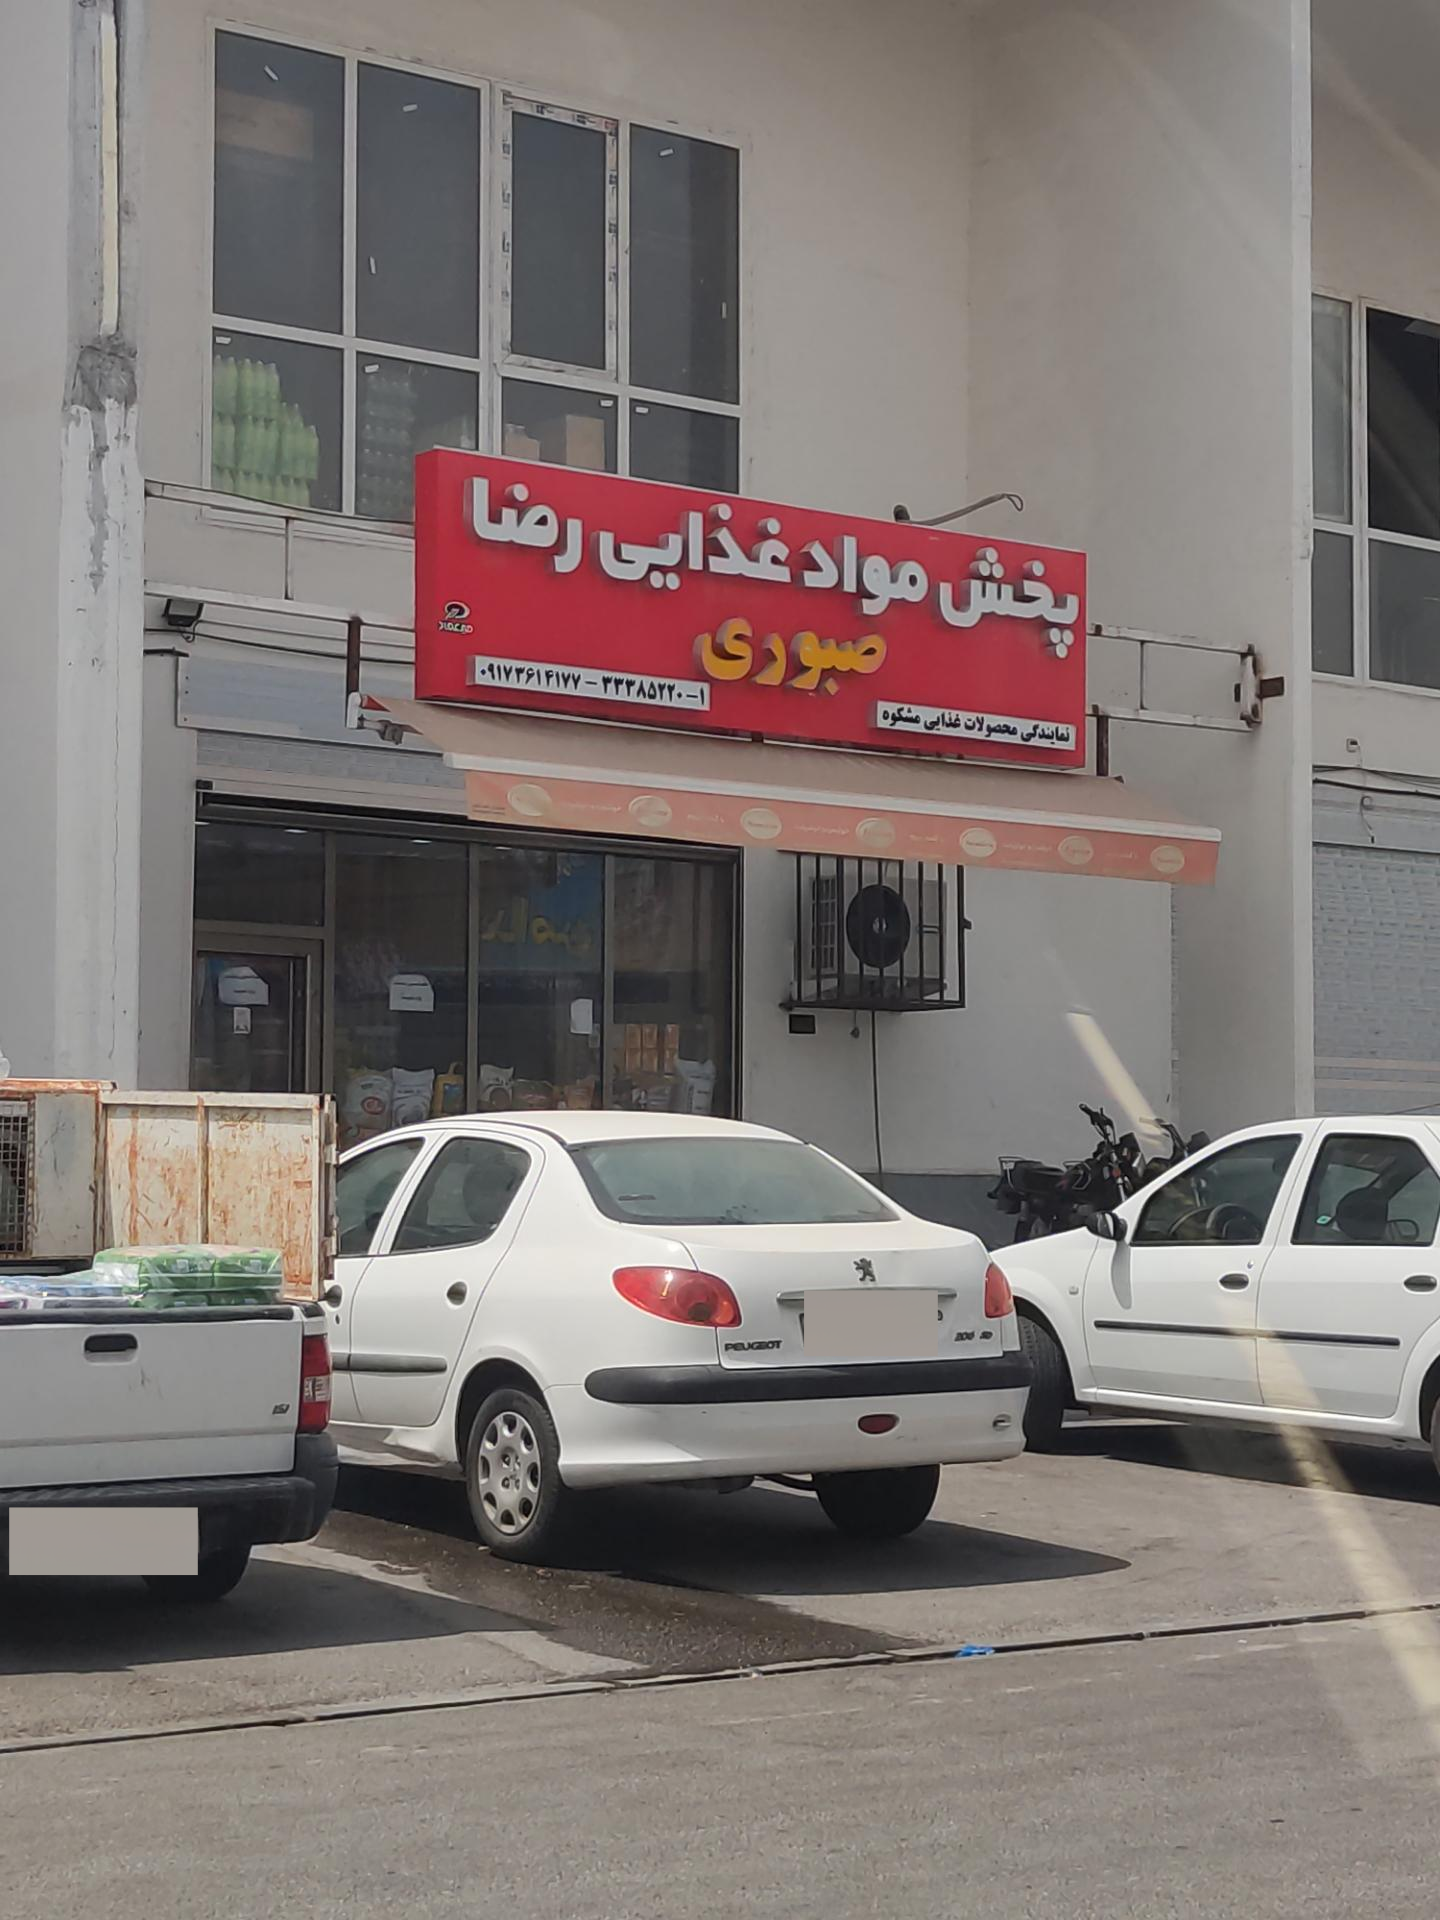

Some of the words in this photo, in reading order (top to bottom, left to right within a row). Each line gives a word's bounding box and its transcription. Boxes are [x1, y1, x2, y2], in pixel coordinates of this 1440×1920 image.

[465, 476, 583, 573] رضا
[594, 503, 792, 590] غذایی
[801, 535, 929, 616] مواد
[938, 547, 1079, 659] پخش
[694, 617, 887, 696] صبوری
[923, 711, 961, 731] غذایی
[964, 715, 1018, 738] محصولات
[1020, 723, 1070, 745] نمایندگی
[724, 1339, 783, 1352] PEUGEOT
